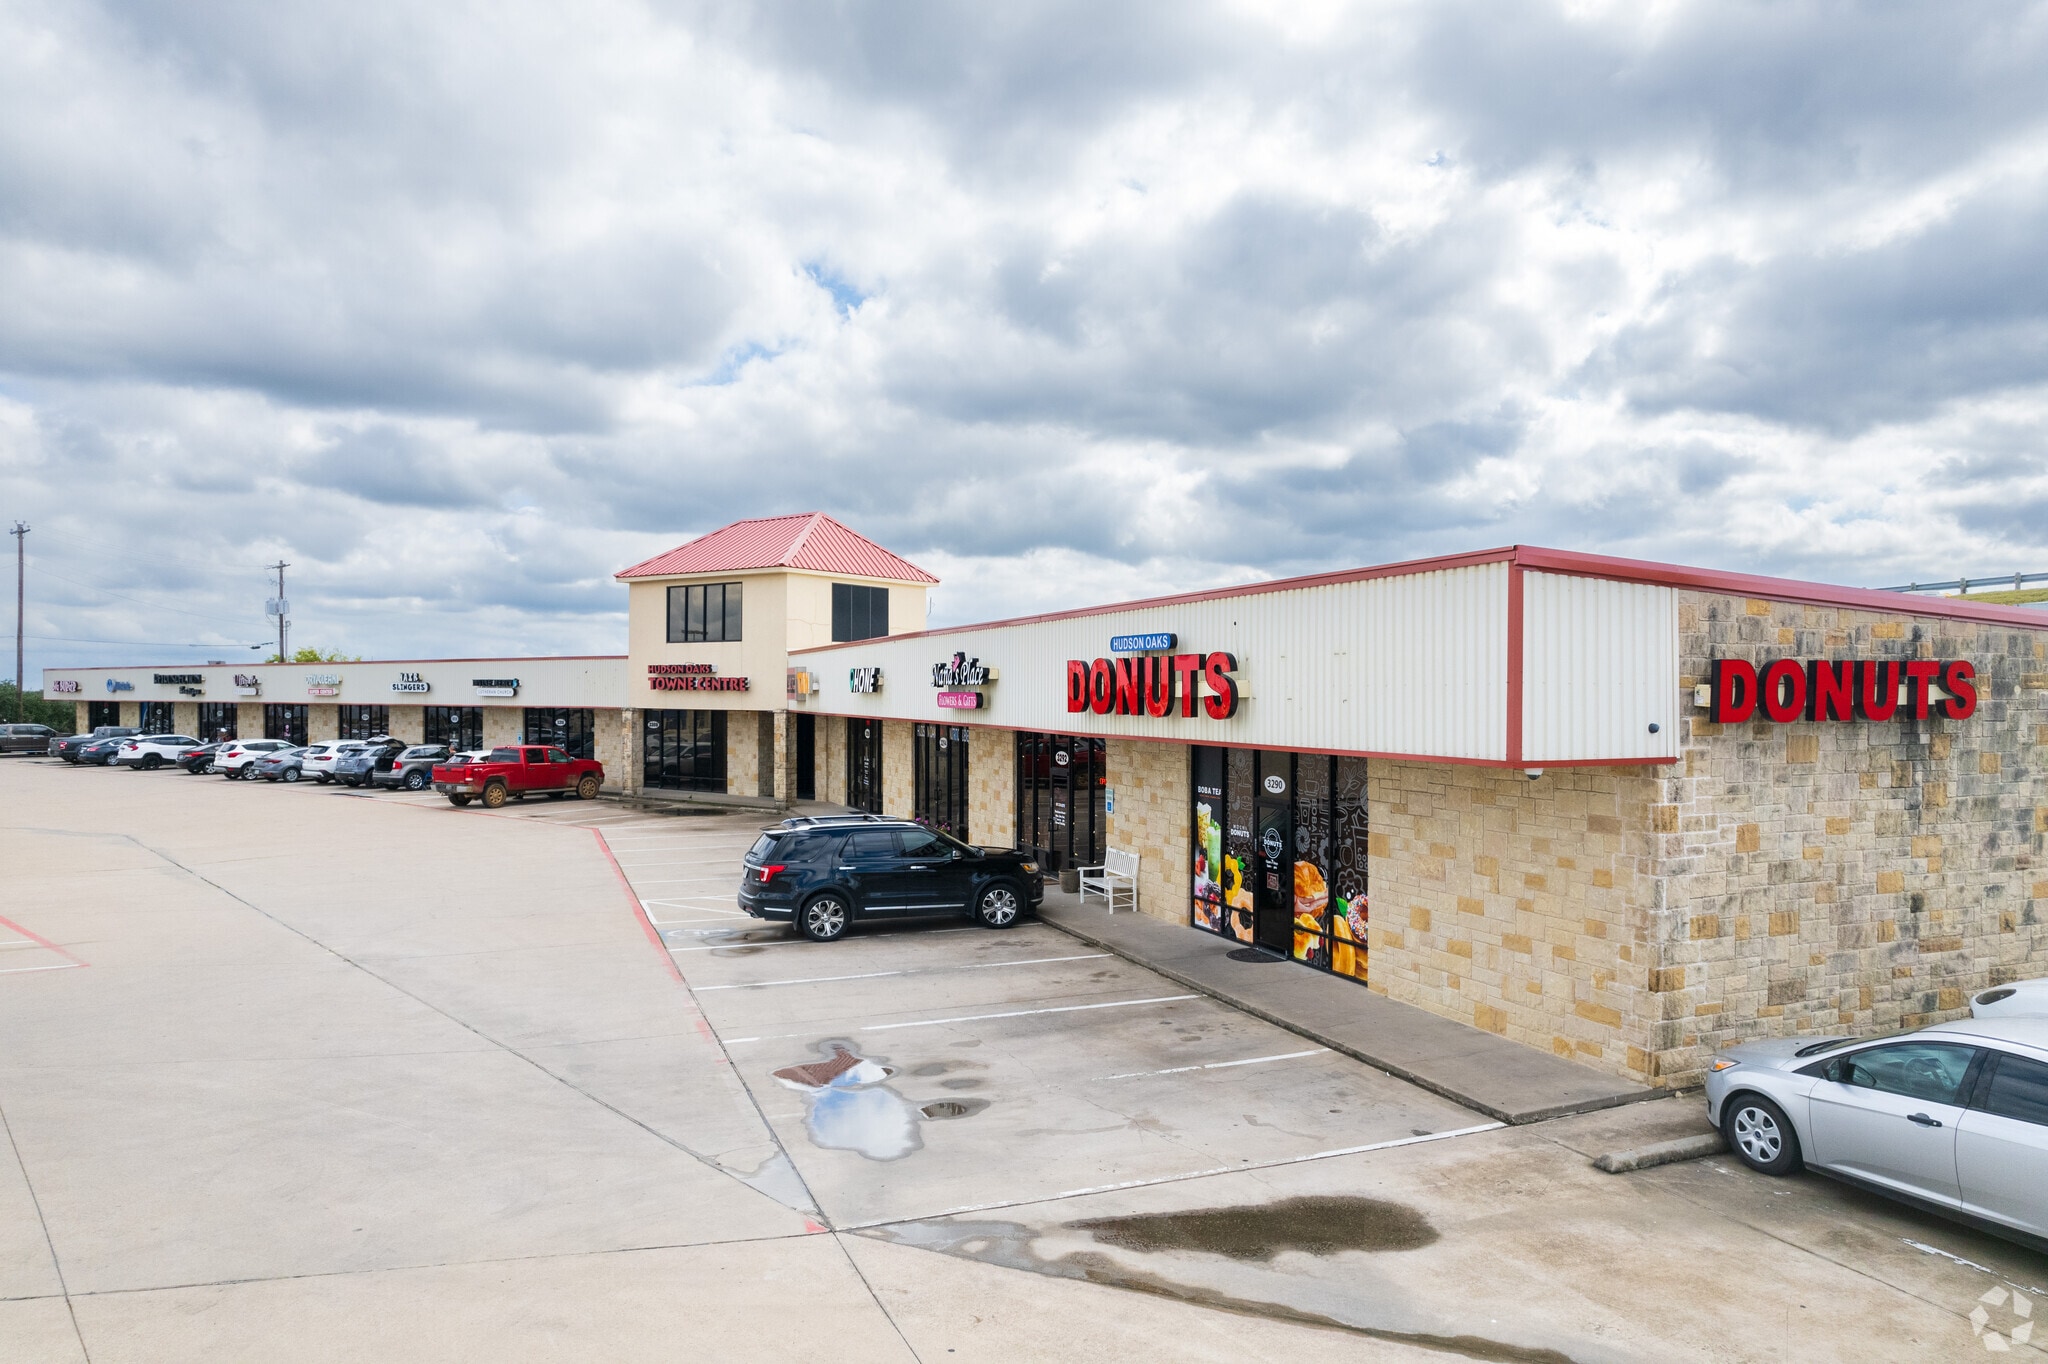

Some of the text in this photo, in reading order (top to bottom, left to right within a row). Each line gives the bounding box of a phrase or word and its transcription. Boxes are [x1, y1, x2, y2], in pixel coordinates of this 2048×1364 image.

[1113, 635, 1168, 650] HUDSON OAKS
[648, 664, 711, 674] HUDSON OAKS
[932, 660, 984, 687] Nana's Place
[392, 683, 425, 691] SLINGERS
[648, 677, 747, 691] TOWNE CENTRE
[1067, 651, 1238, 720] DONUTS
[1710, 658, 1958, 724] DONUTS
[1267, 779, 1283, 789] 3290
[1197, 785, 1212, 795] BOBA
[1230, 828, 1250, 838] DONUTS
[1263, 839, 1283, 848] DONUTS
